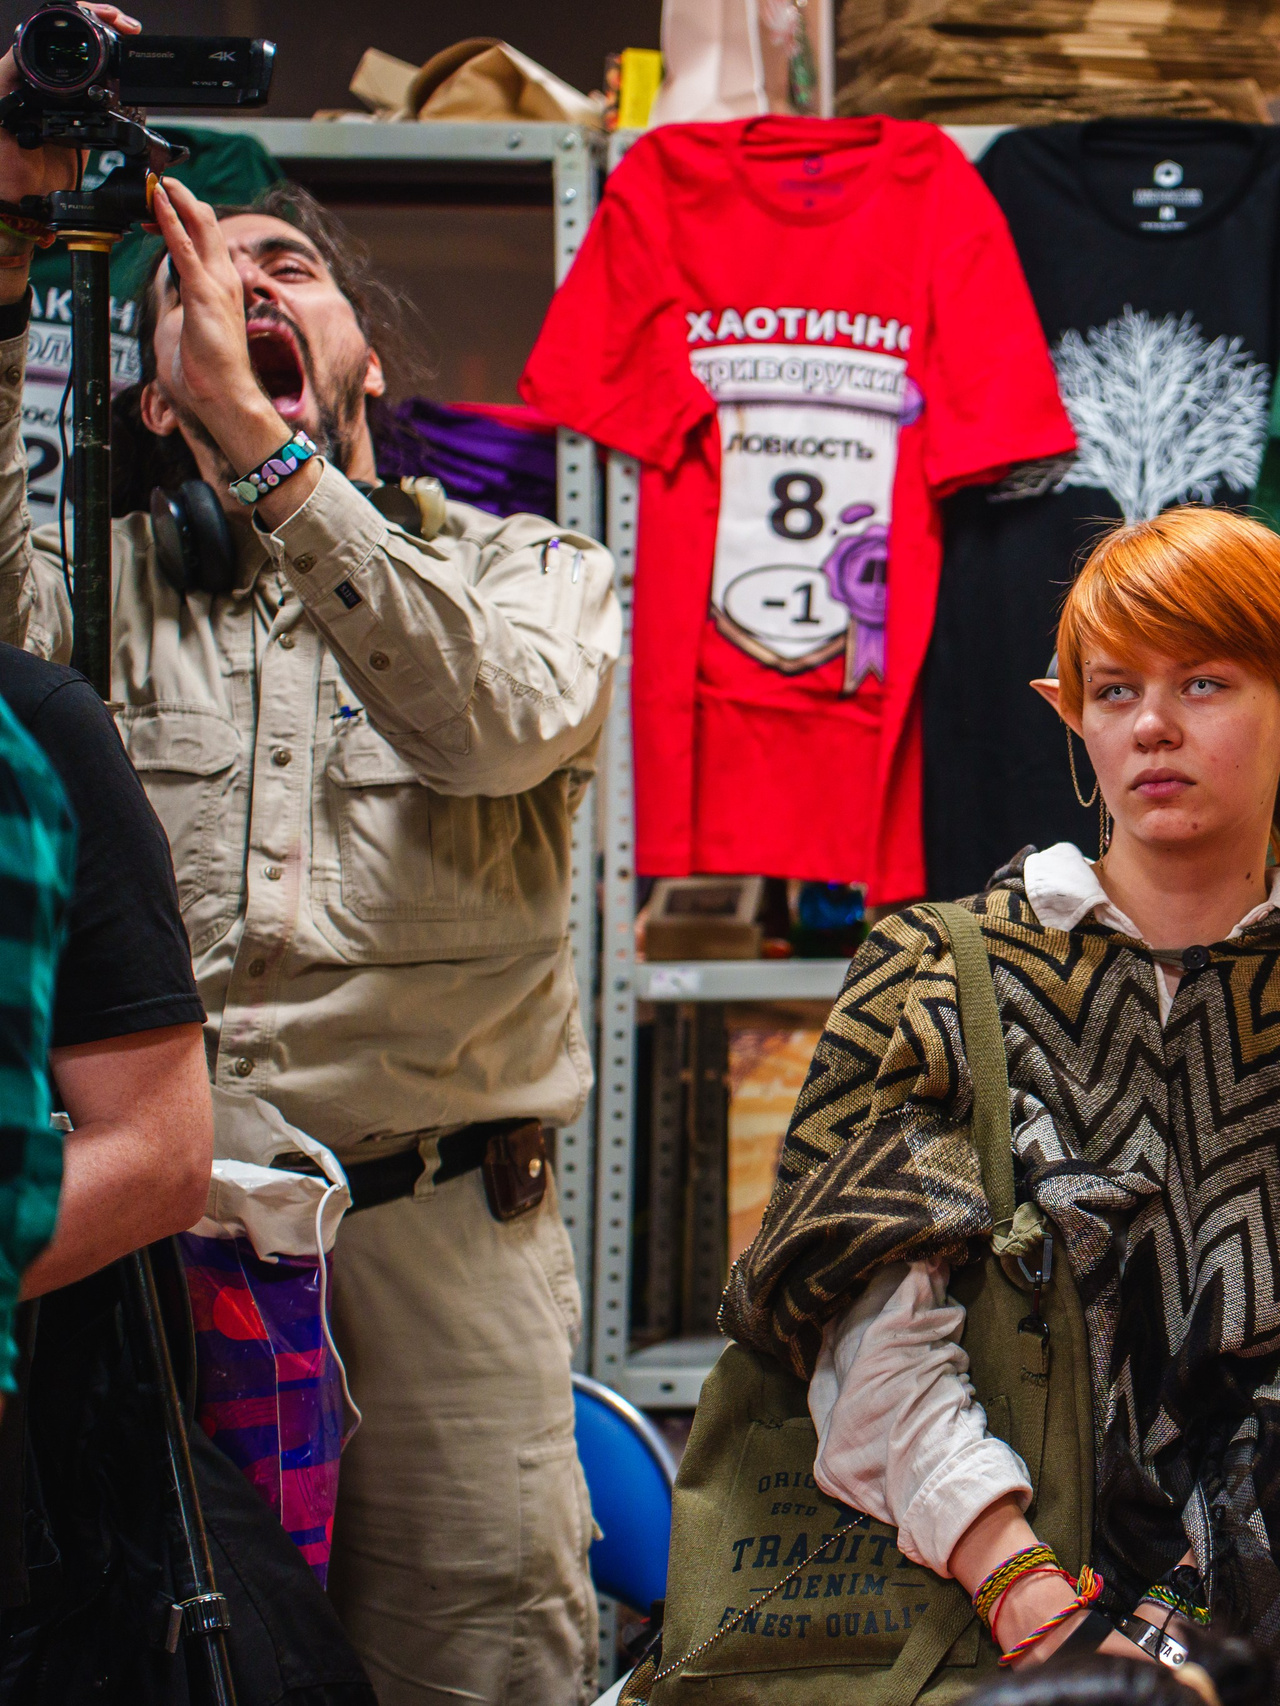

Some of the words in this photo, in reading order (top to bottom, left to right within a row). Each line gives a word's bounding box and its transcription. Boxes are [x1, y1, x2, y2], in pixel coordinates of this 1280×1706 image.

[128, 50, 175, 59] Panasonic
[207, 51, 236, 62] 4K
[726, 432, 875, 461] ЛОВКОСТЬ
[769, 472, 826, 541] 8
[761, 582, 821, 624] -1
[757, 1472, 818, 1494] ORIG
[771, 1502, 818, 1517] ESTD
[732, 1532, 910, 1573] TRADIT
[782, 1573, 888, 1601] DENIM
[825, 1603, 930, 1638] QUALI
